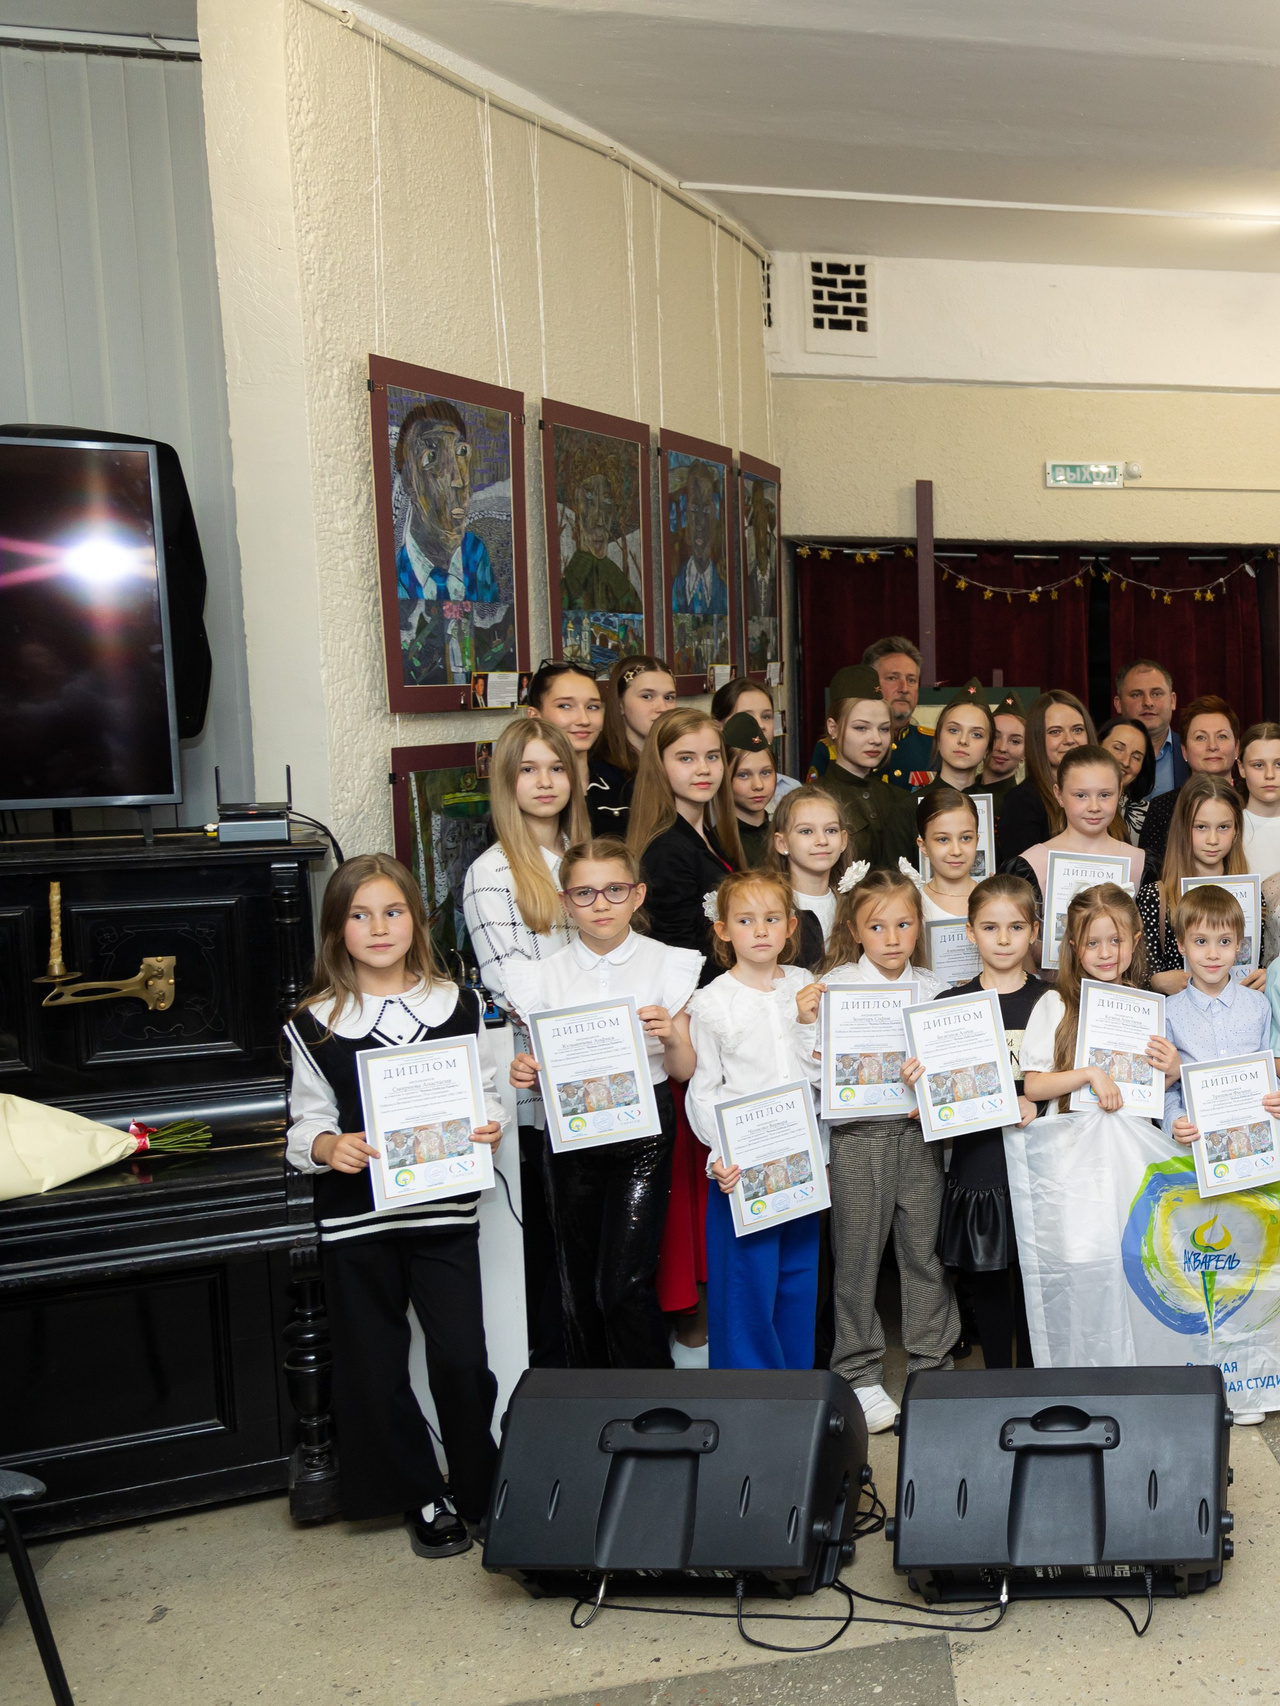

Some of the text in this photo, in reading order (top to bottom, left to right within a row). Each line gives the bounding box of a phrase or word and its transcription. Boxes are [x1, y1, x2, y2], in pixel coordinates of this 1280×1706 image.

[1055, 466, 1115, 482] ВЫХОД
[1062, 868, 1114, 879] ДИПЛОМ
[841, 1000, 902, 1011] ДИПЛОМ
[1097, 998, 1151, 1015] ДИПЛОМ
[551, 1017, 620, 1038] ДИПЛОМ
[922, 1011, 983, 1031] ДИПЛОМ
[383, 1059, 457, 1080] ДИПЛОМ
[1201, 1071, 1259, 1089] ДИПЛОМ
[735, 1101, 796, 1126] ДИПЛОМ
[1183, 1249, 1241, 1272] АКВАРЕЛЬ
